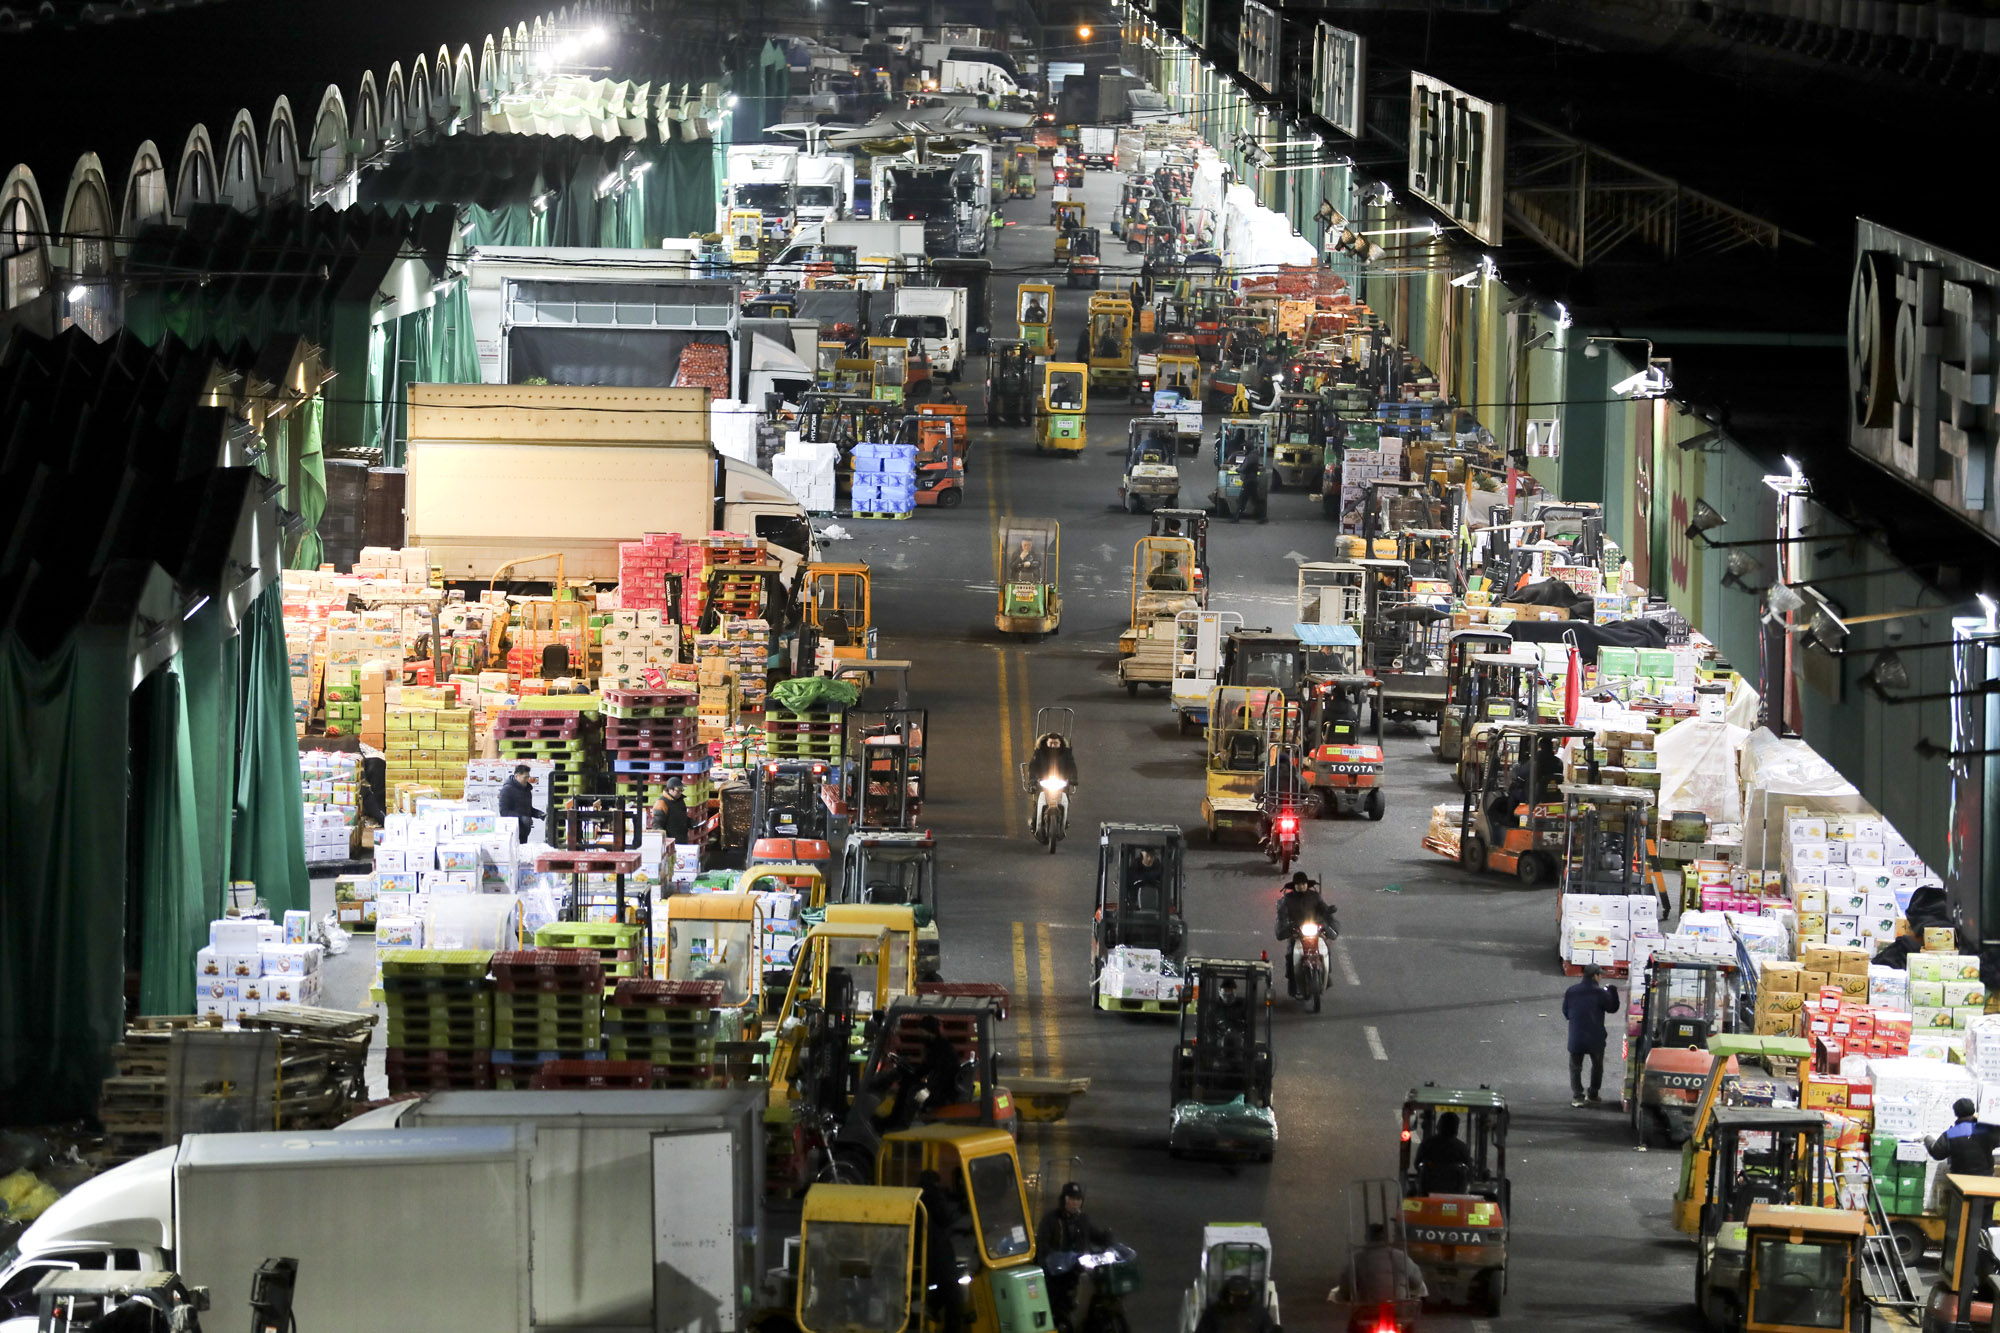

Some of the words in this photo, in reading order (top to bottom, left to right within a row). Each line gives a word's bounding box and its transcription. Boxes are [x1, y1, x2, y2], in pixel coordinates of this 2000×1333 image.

[1331, 764, 1374, 772] TOYOTA
[1534, 806, 1548, 816] 21
[1663, 1075, 1709, 1088] TOYO
[1416, 1229, 1481, 1243] TOYOTA
